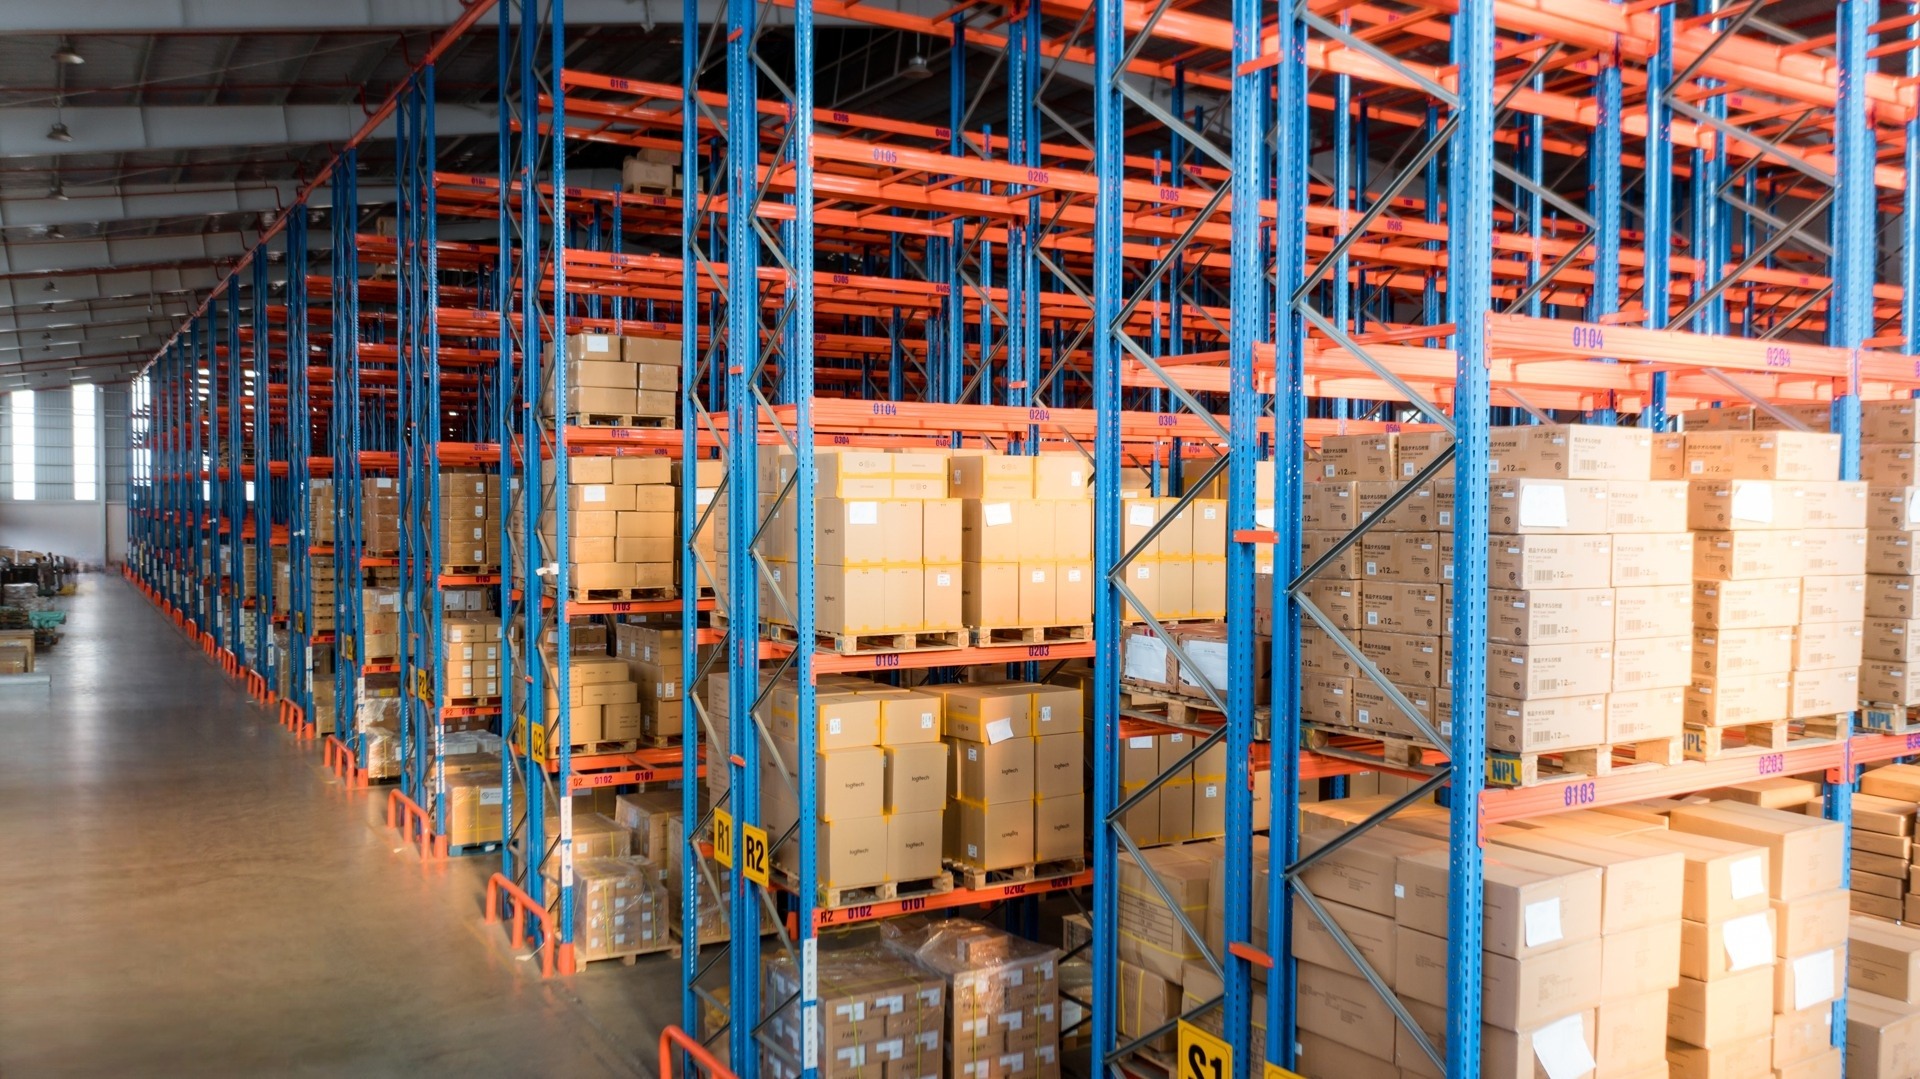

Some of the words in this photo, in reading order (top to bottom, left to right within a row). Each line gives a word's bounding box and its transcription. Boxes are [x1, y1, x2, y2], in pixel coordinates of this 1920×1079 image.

[873, 148, 897, 163] 0105
[1028, 169, 1049, 184] 0205
[1160, 188, 1179, 201] 0305
[1573, 326, 1603, 350] 0104
[1766, 347, 1791, 368] 0204
[873, 402, 897, 416] 0104
[1029, 408, 1050, 421] 0204
[1158, 414, 1178, 426] 0304
[834, 435, 850, 445] 0304
[612, 602, 631, 612] 0103
[1028, 644, 1050, 658] 0203
[875, 654, 899, 667] 0103
[1868, 711, 1893, 730] NPL
[1001, 766, 1019, 776] logitech
[1053, 761, 1070, 770] logitech
[1759, 753, 1784, 775] 0203
[594, 775, 613, 785] 0102
[635, 771, 654, 781] 0101
[911, 774, 930, 783] logitech
[1492, 759, 1519, 784] NPL
[1563, 781, 1595, 807] 0103
[1053, 822, 1070, 832] logitech
[717, 820, 730, 856] R1
[905, 840, 925, 849] logitech
[745, 834, 765, 875] R2
[1004, 883, 1026, 895] 0202
[820, 910, 834, 923] R2
[847, 905, 872, 920] 0102
[901, 897, 926, 912] 0101
[842, 1029, 864, 1039] FANY
[1187, 1044, 1223, 1079] S1
